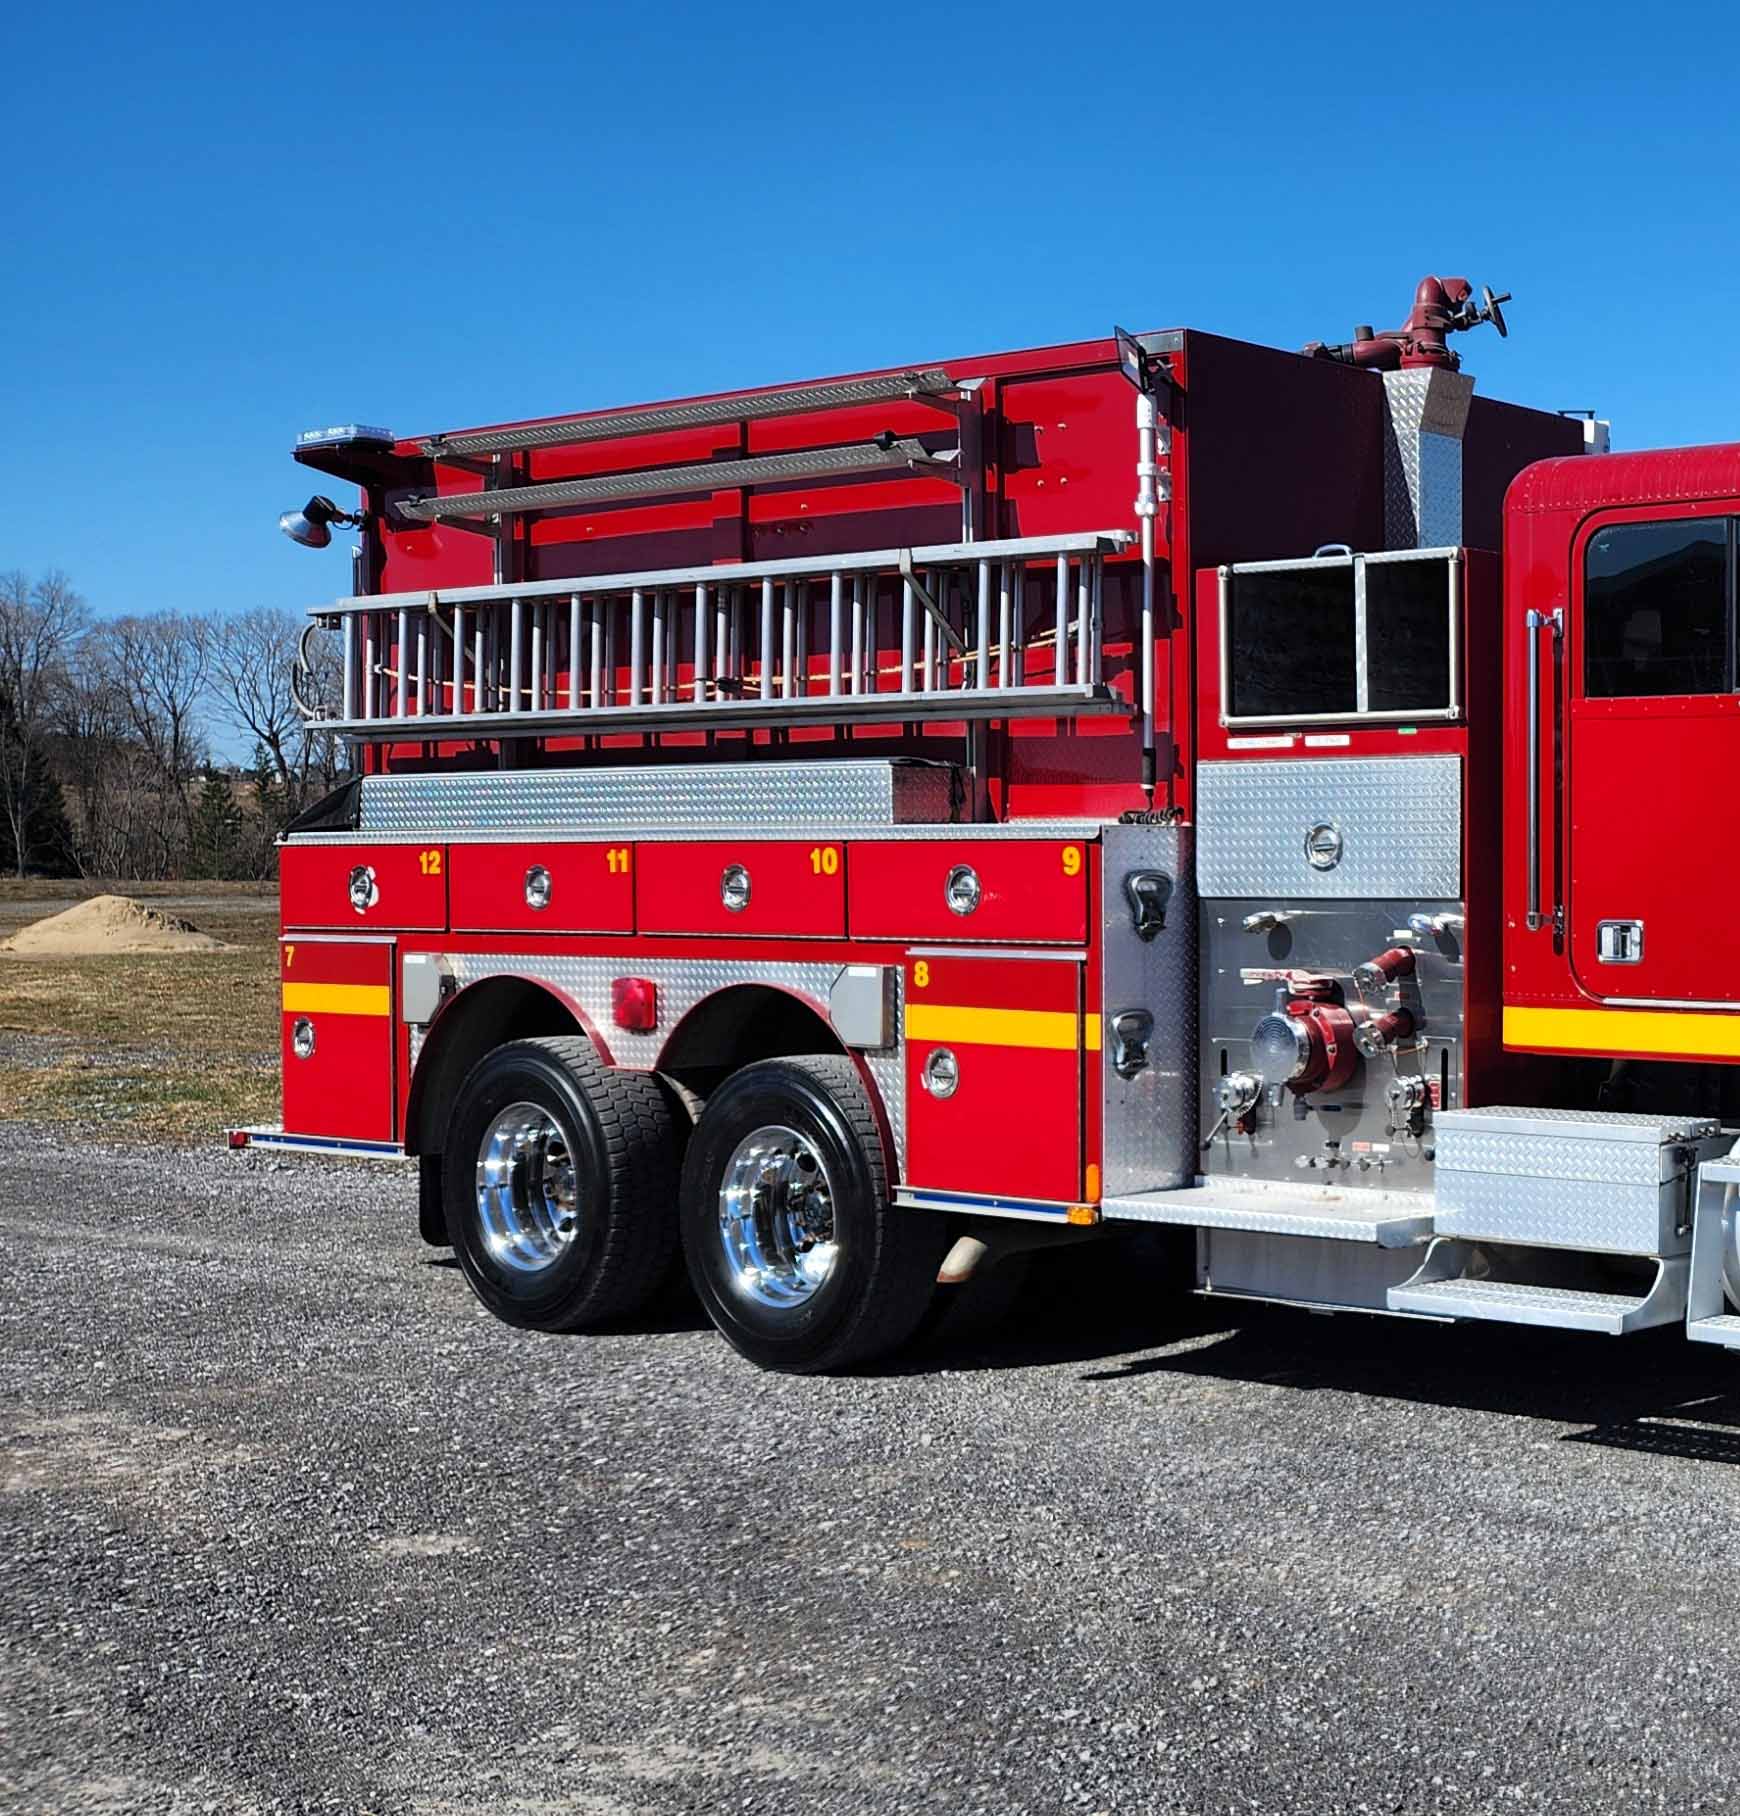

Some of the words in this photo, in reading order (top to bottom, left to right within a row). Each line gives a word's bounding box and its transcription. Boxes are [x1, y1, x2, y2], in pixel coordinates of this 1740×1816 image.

[418, 850, 441, 875] 12
[606, 848, 628, 873] 11
[809, 847, 838, 875] 10
[1061, 846, 1082, 876] 9
[285, 945, 295, 967] 7
[913, 960, 930, 988] 8
